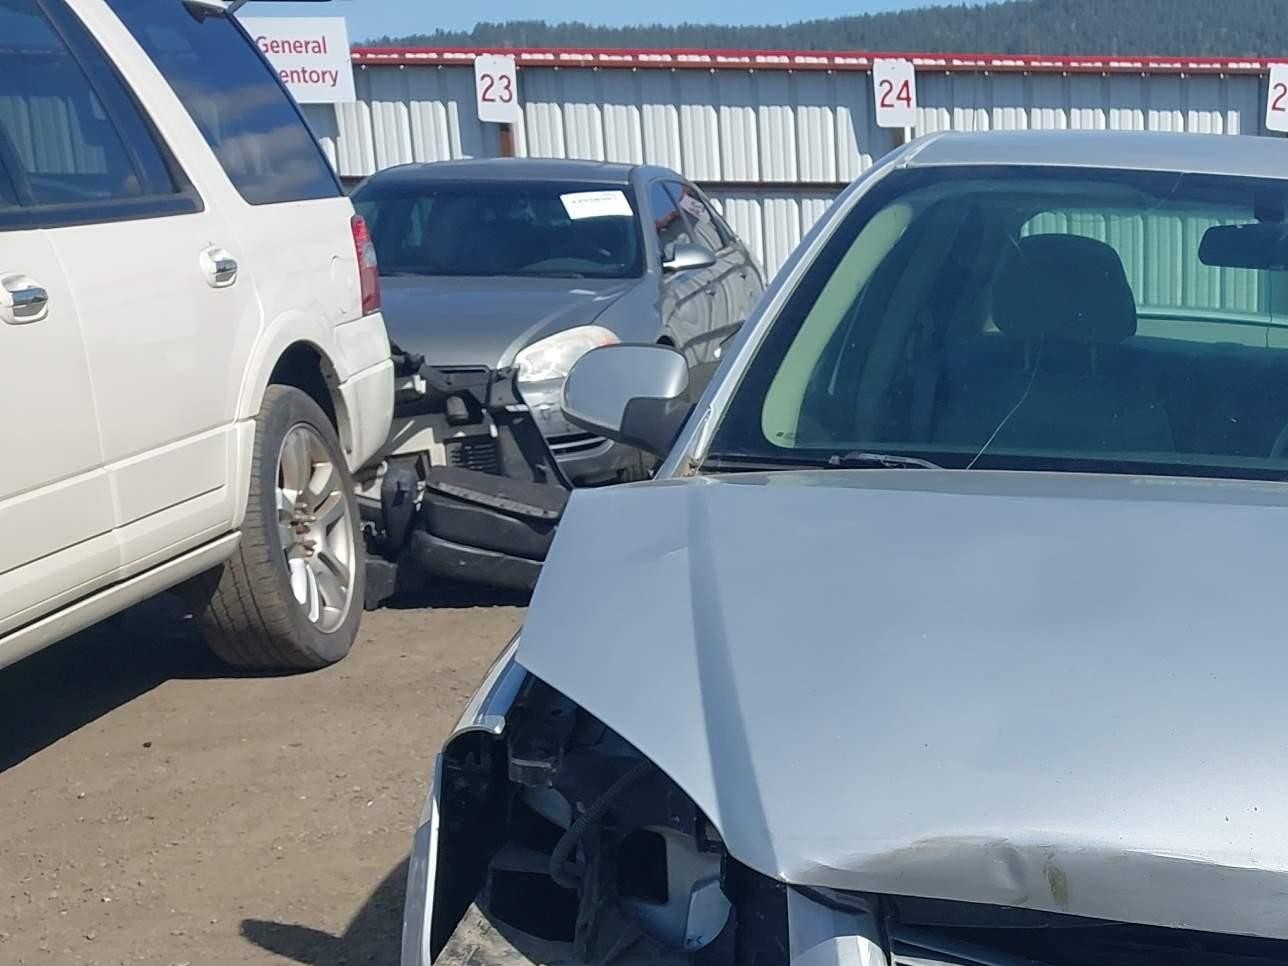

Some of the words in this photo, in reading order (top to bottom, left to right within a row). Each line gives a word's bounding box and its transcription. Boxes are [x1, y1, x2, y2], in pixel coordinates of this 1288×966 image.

[256, 36, 327, 54] General
[279, 67, 338, 87] entory
[481, 74, 512, 103] 23
[880, 80, 911, 108] 24
